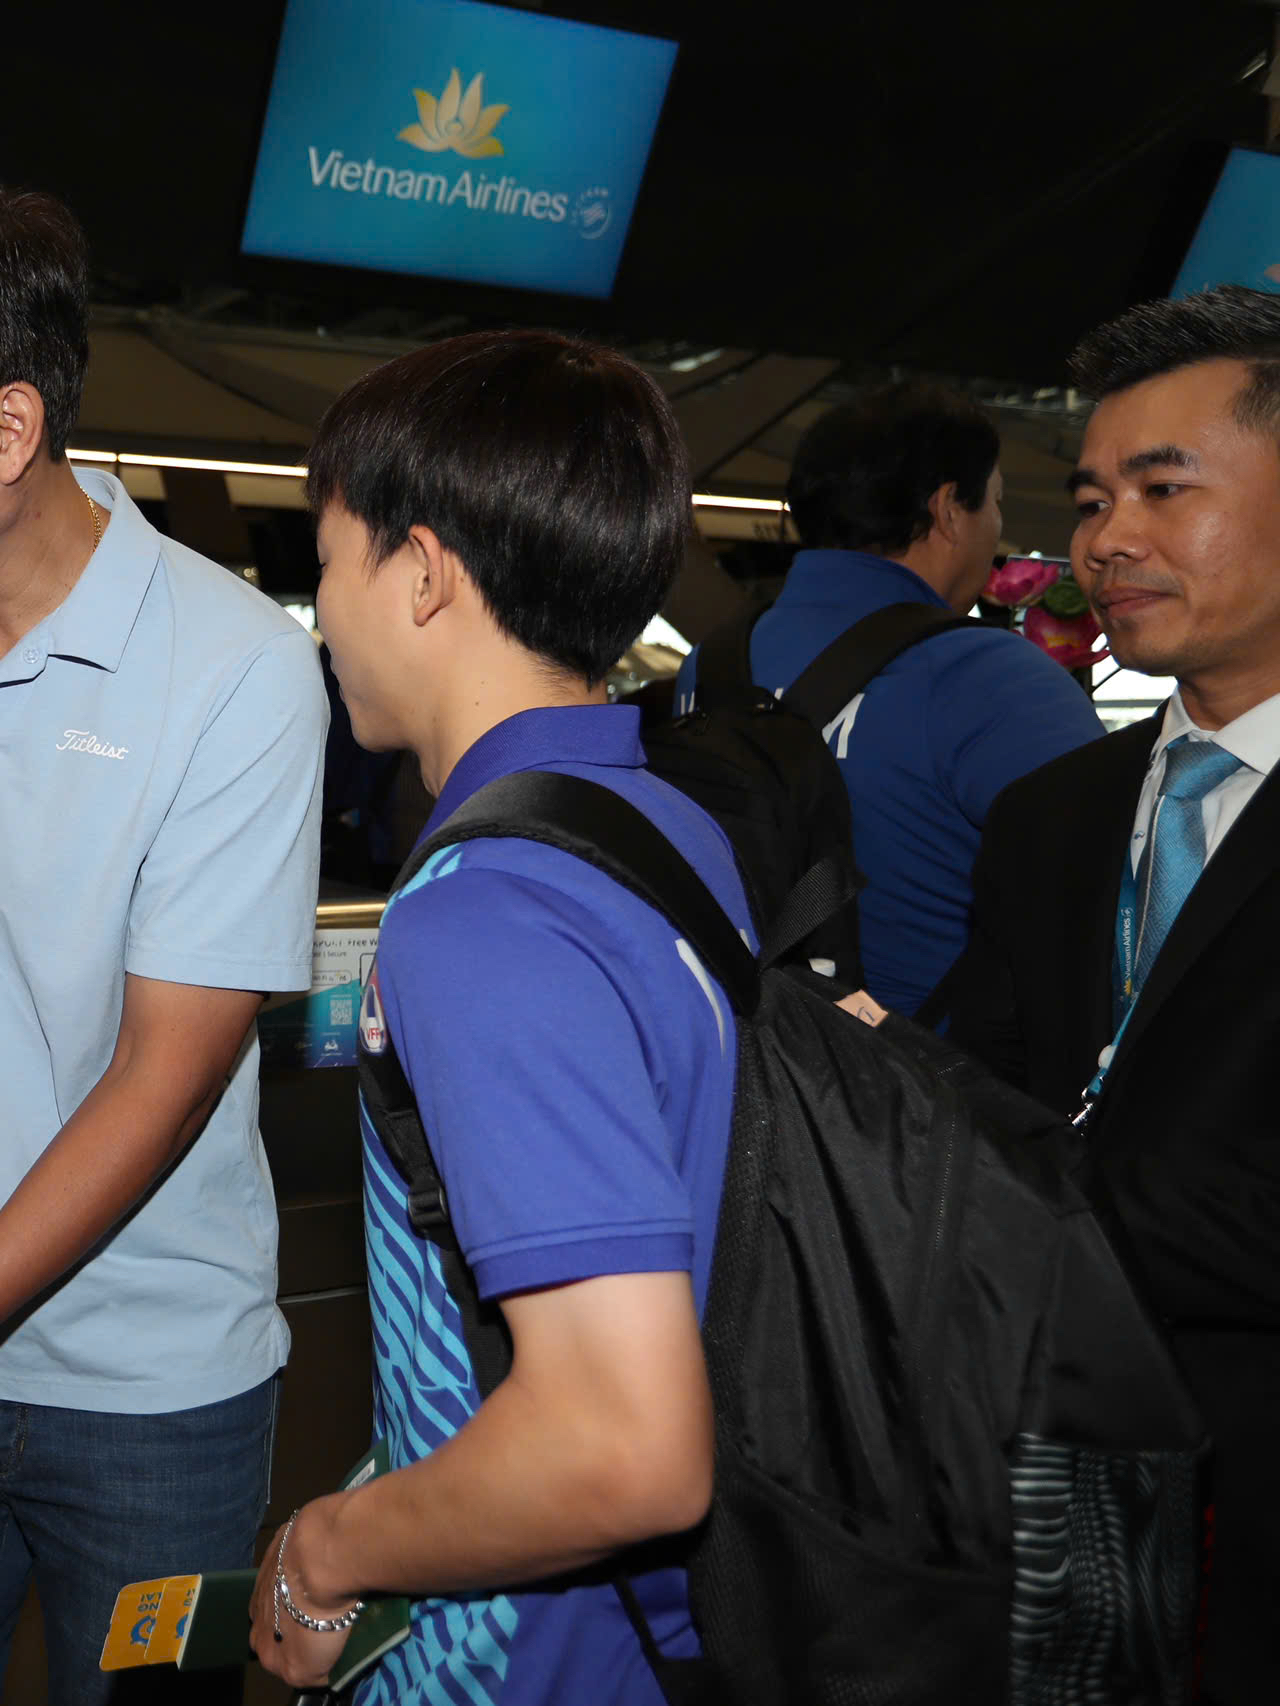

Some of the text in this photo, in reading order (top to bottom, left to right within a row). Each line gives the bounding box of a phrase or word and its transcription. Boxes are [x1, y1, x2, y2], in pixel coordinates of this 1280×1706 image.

[307, 146, 447, 204] Vietnam
[447, 171, 568, 223] Airlines
[55, 729, 129, 760] Titleist
[1123, 917, 1131, 946] Airlines
